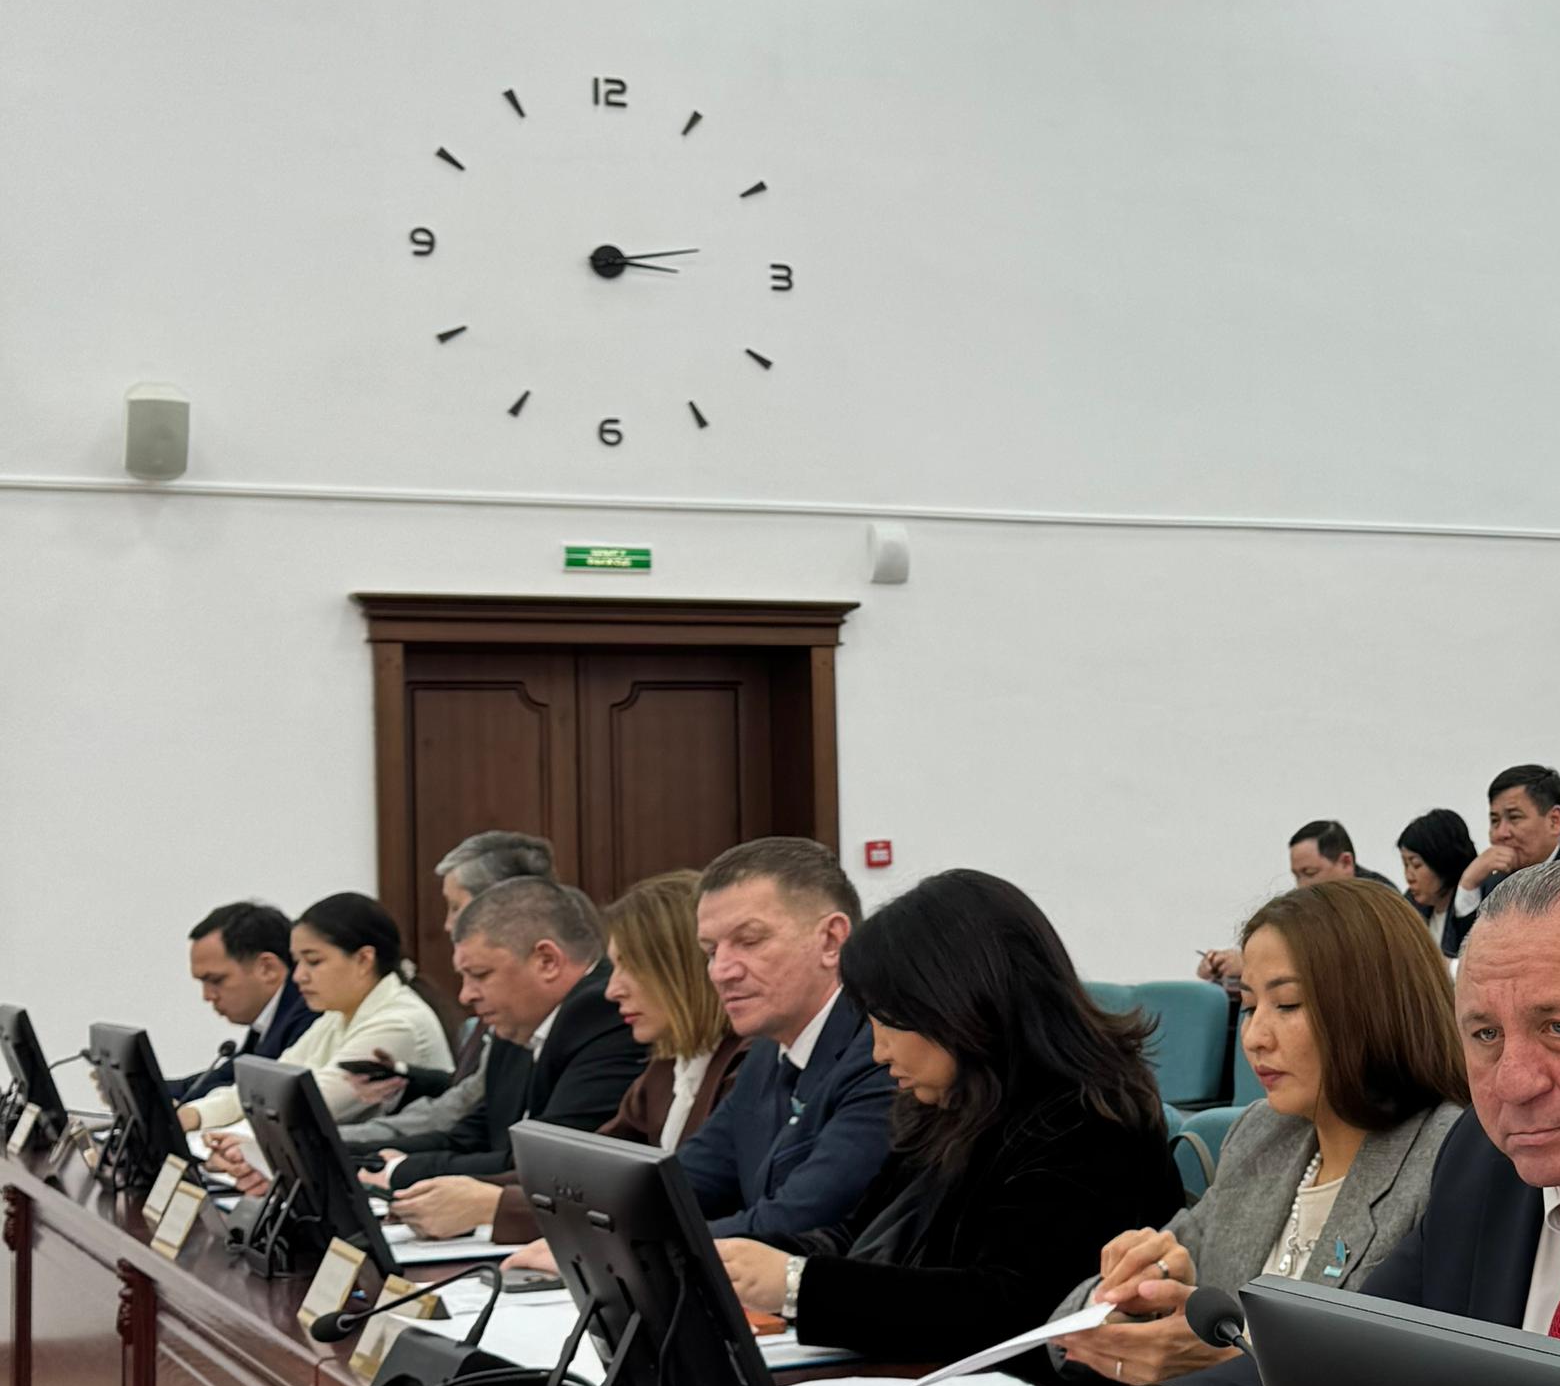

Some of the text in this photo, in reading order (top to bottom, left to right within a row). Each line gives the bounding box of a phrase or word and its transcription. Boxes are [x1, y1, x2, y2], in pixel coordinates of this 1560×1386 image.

[593, 77, 628, 108] 12
[409, 227, 435, 257] 9
[770, 264, 794, 292] 3
[599, 418, 623, 447] 6
